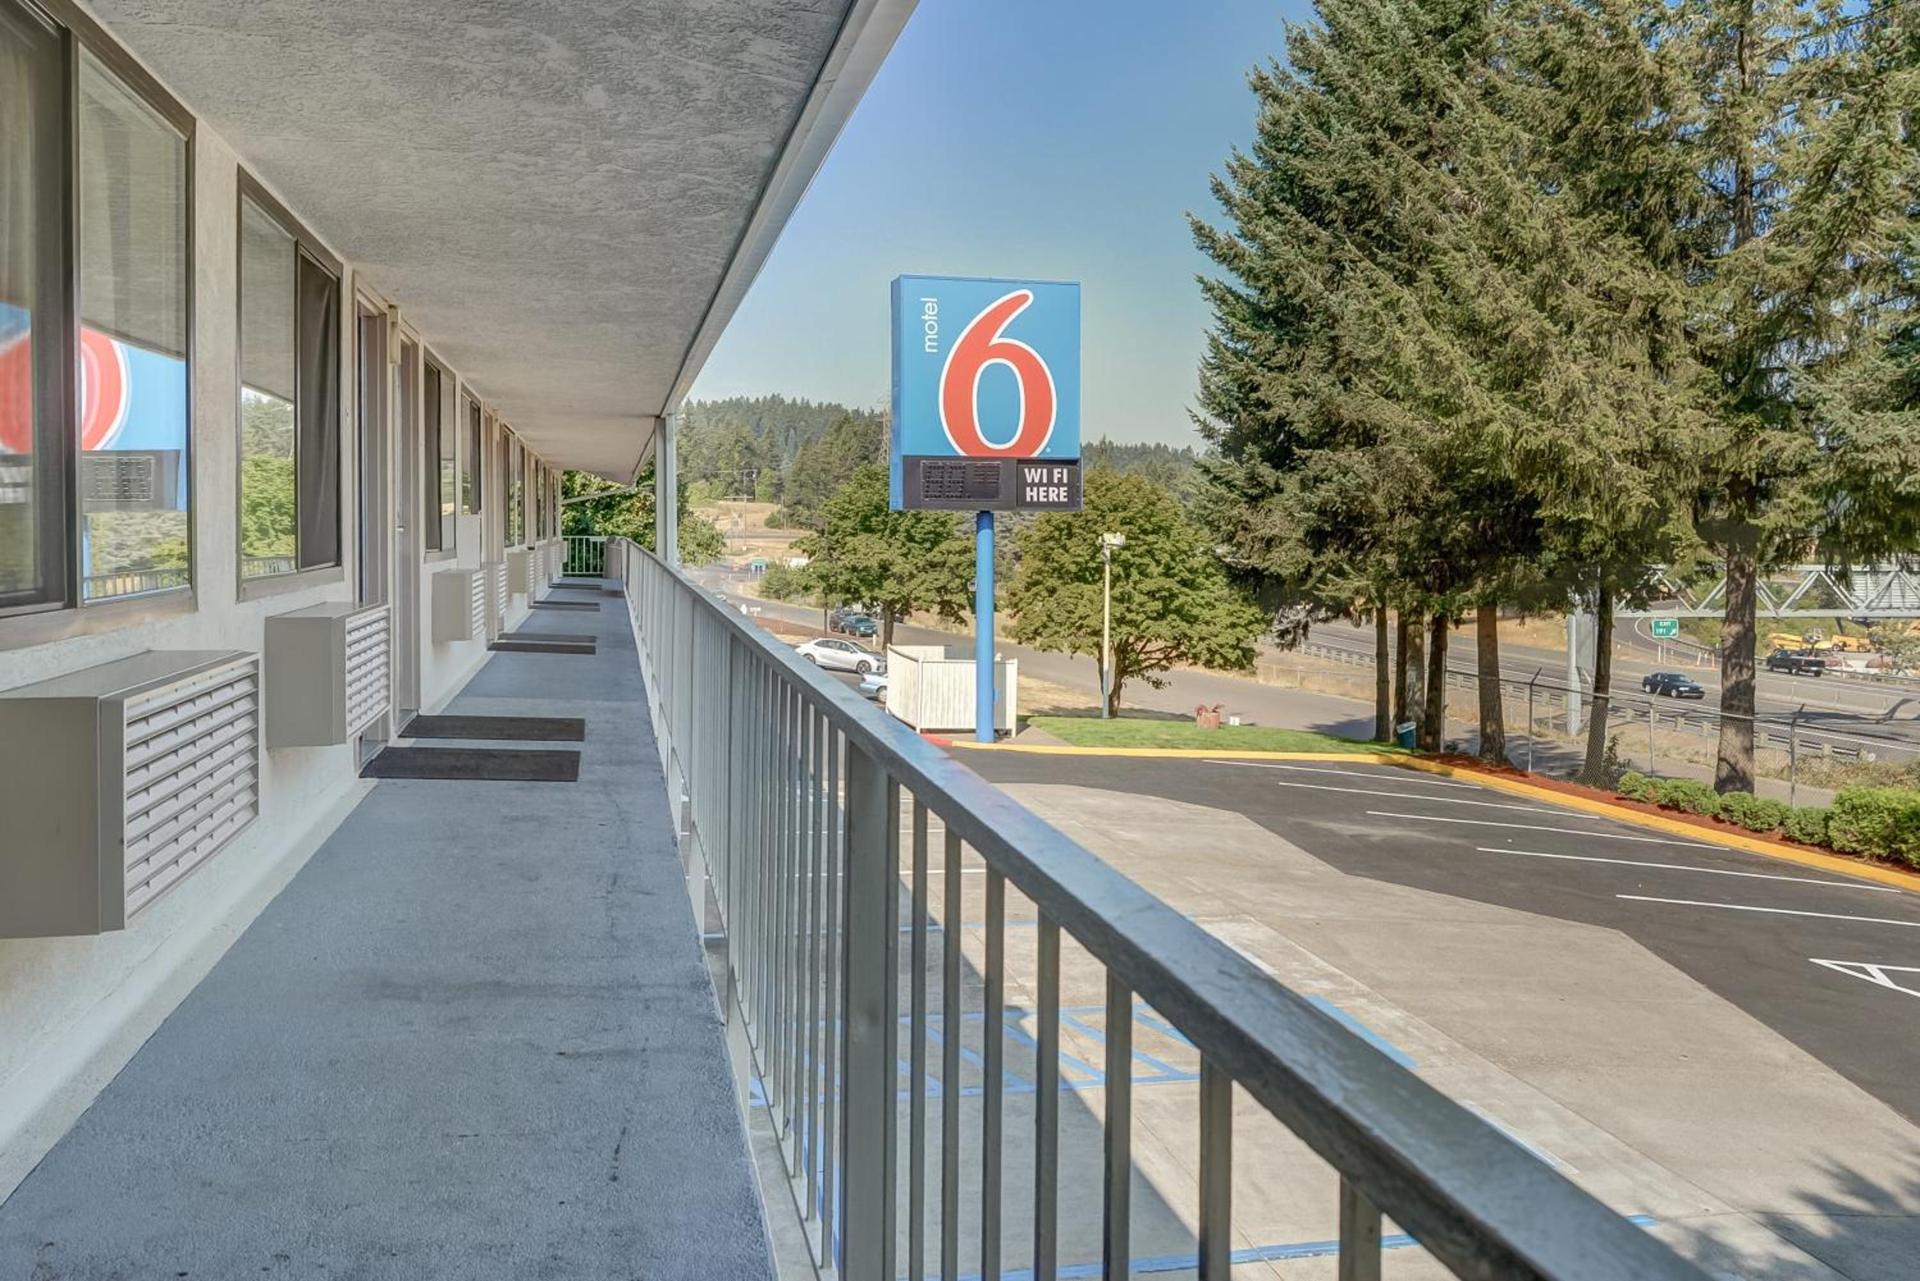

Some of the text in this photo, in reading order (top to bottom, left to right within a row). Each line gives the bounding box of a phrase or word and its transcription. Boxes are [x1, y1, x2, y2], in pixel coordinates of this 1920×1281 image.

[920, 288, 1057, 457] motel 6
[1024, 468, 1068, 483] WI FI
[1026, 486, 1068, 502] HERE
